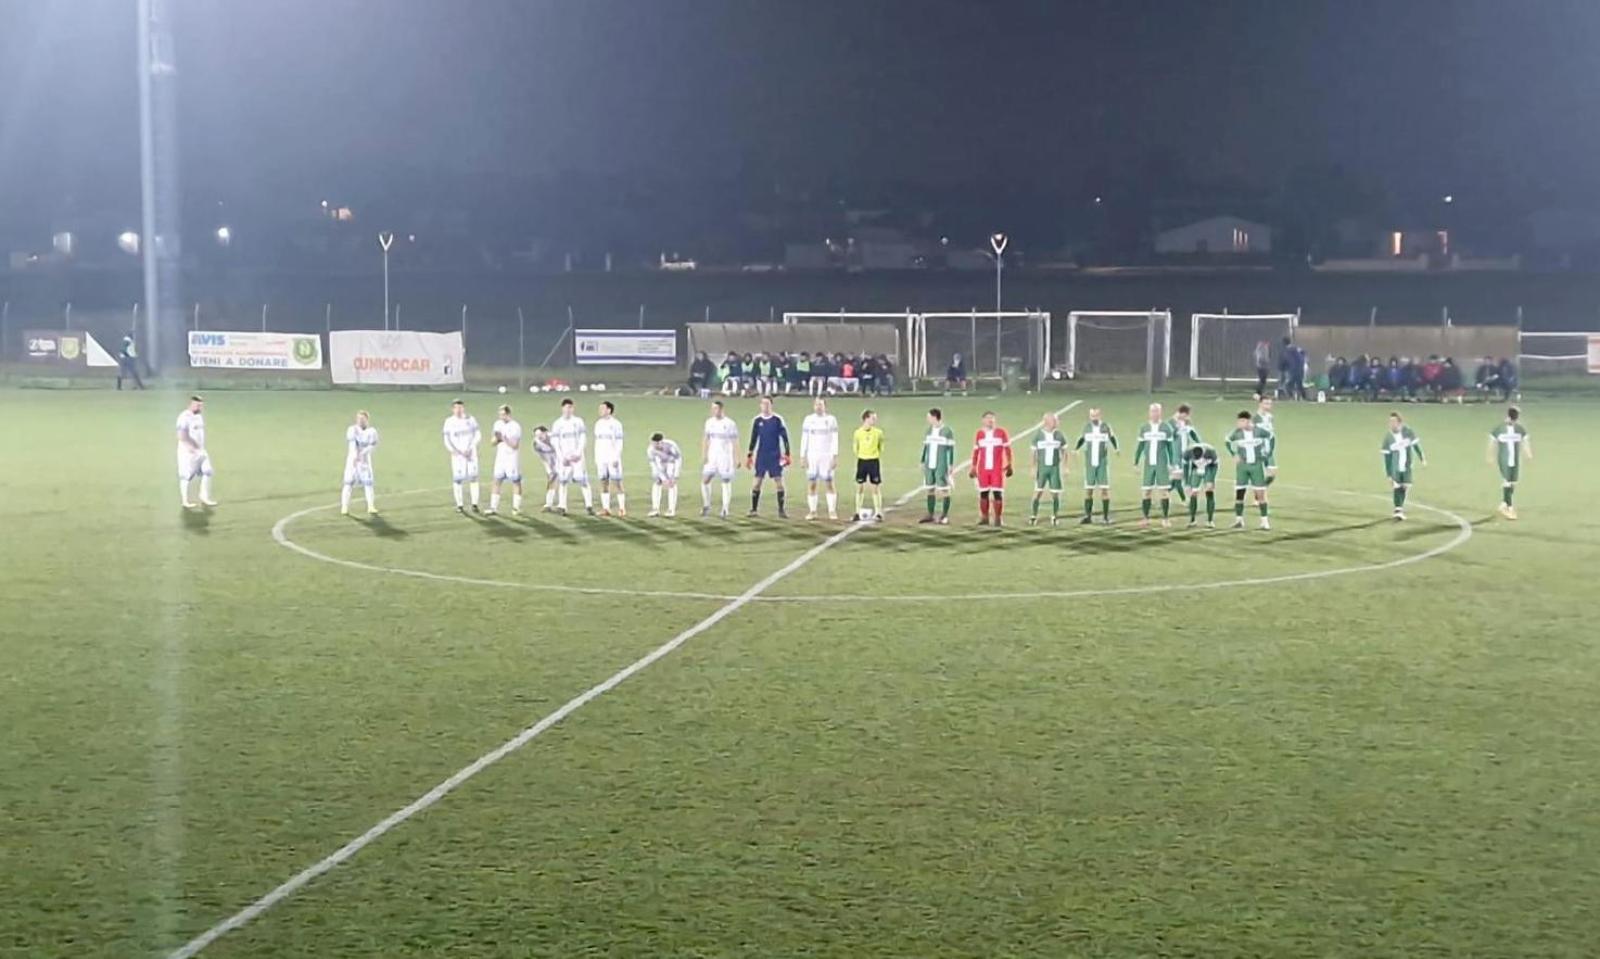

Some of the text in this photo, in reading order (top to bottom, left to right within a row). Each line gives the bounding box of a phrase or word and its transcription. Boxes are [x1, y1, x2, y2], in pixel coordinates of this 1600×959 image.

[191, 335, 225, 345] AVIS
[191, 357, 288, 367] VIENI A DONARE
